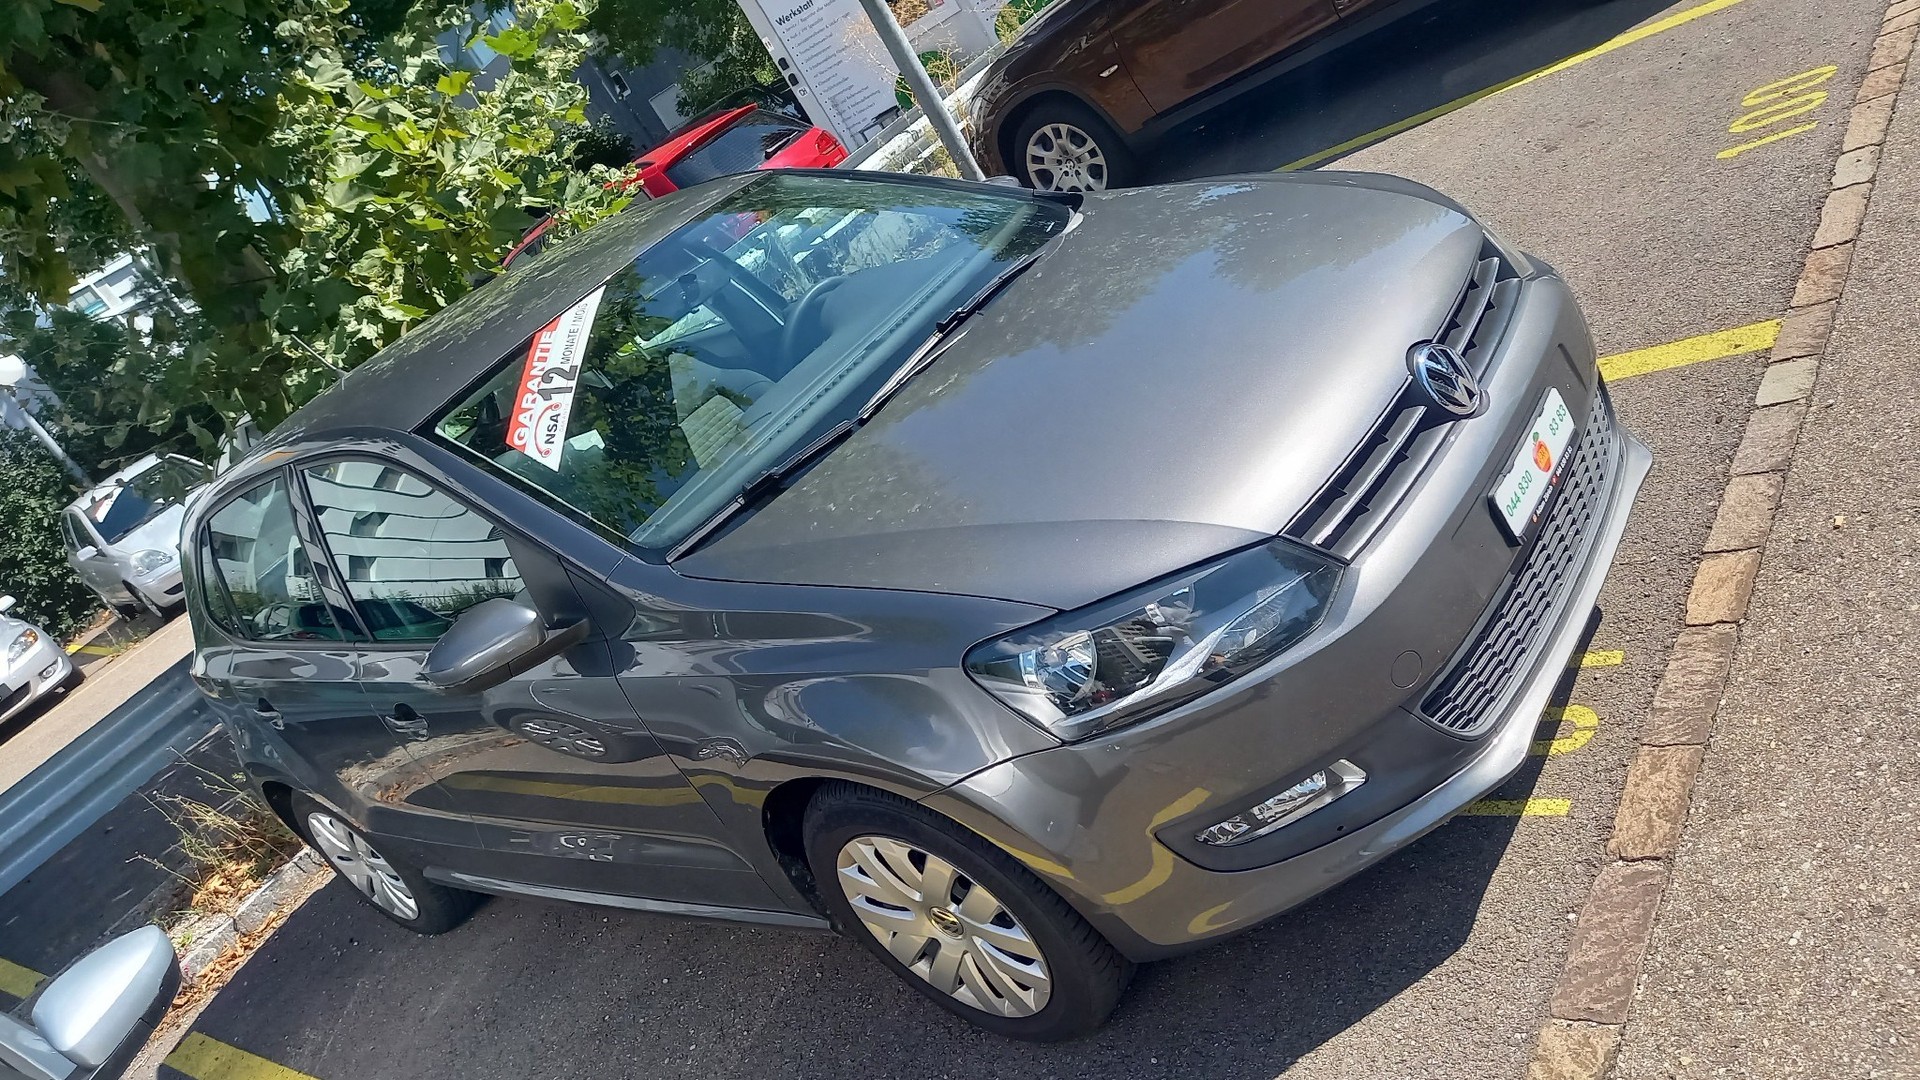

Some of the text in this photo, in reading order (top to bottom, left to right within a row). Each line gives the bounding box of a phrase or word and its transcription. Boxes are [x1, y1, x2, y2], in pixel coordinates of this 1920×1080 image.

[513, 329, 556, 446] GARANTIE
[537, 364, 579, 402] 12
[560, 327, 579, 365] MONATE
[544, 413, 561, 445] NSA
[1506, 404, 1567, 517] 044 830 83 83
